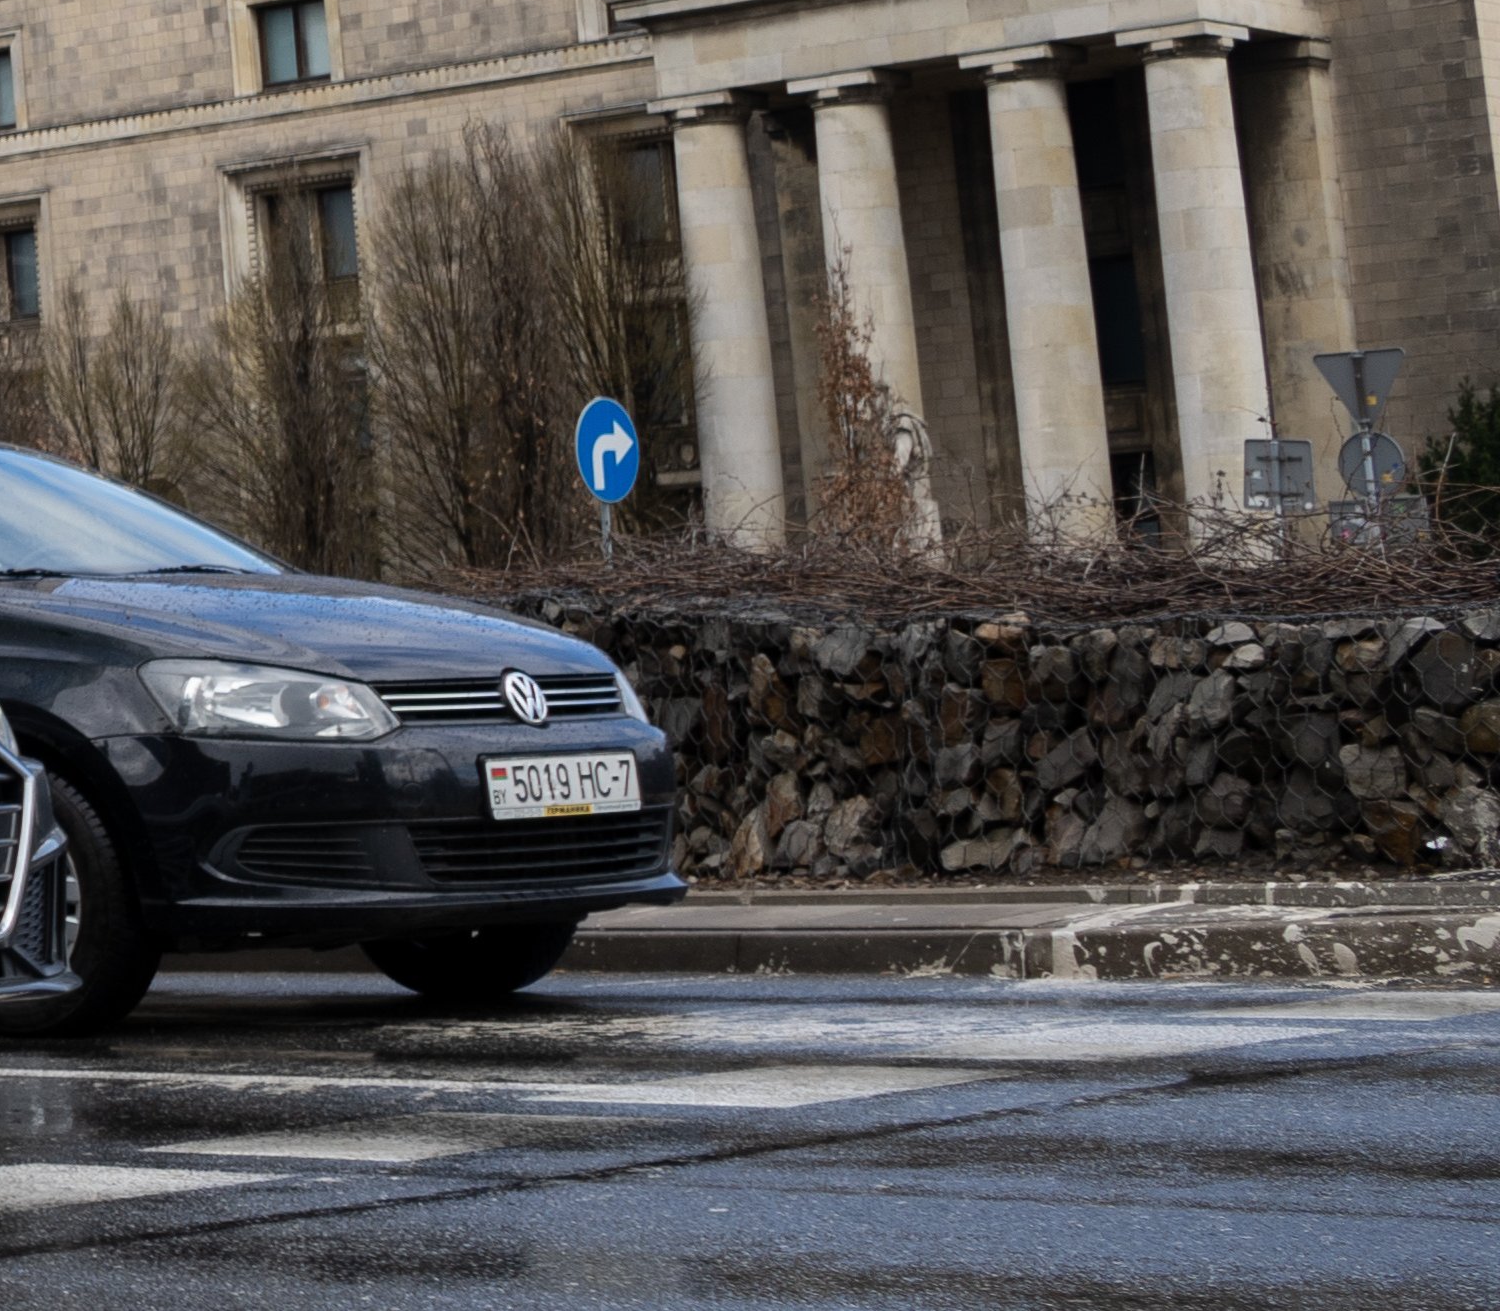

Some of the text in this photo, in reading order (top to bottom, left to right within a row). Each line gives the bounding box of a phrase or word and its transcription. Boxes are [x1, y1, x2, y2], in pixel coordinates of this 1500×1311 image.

[511, 760, 631, 803] 5019 HC-7
[493, 789, 507, 805] BY
